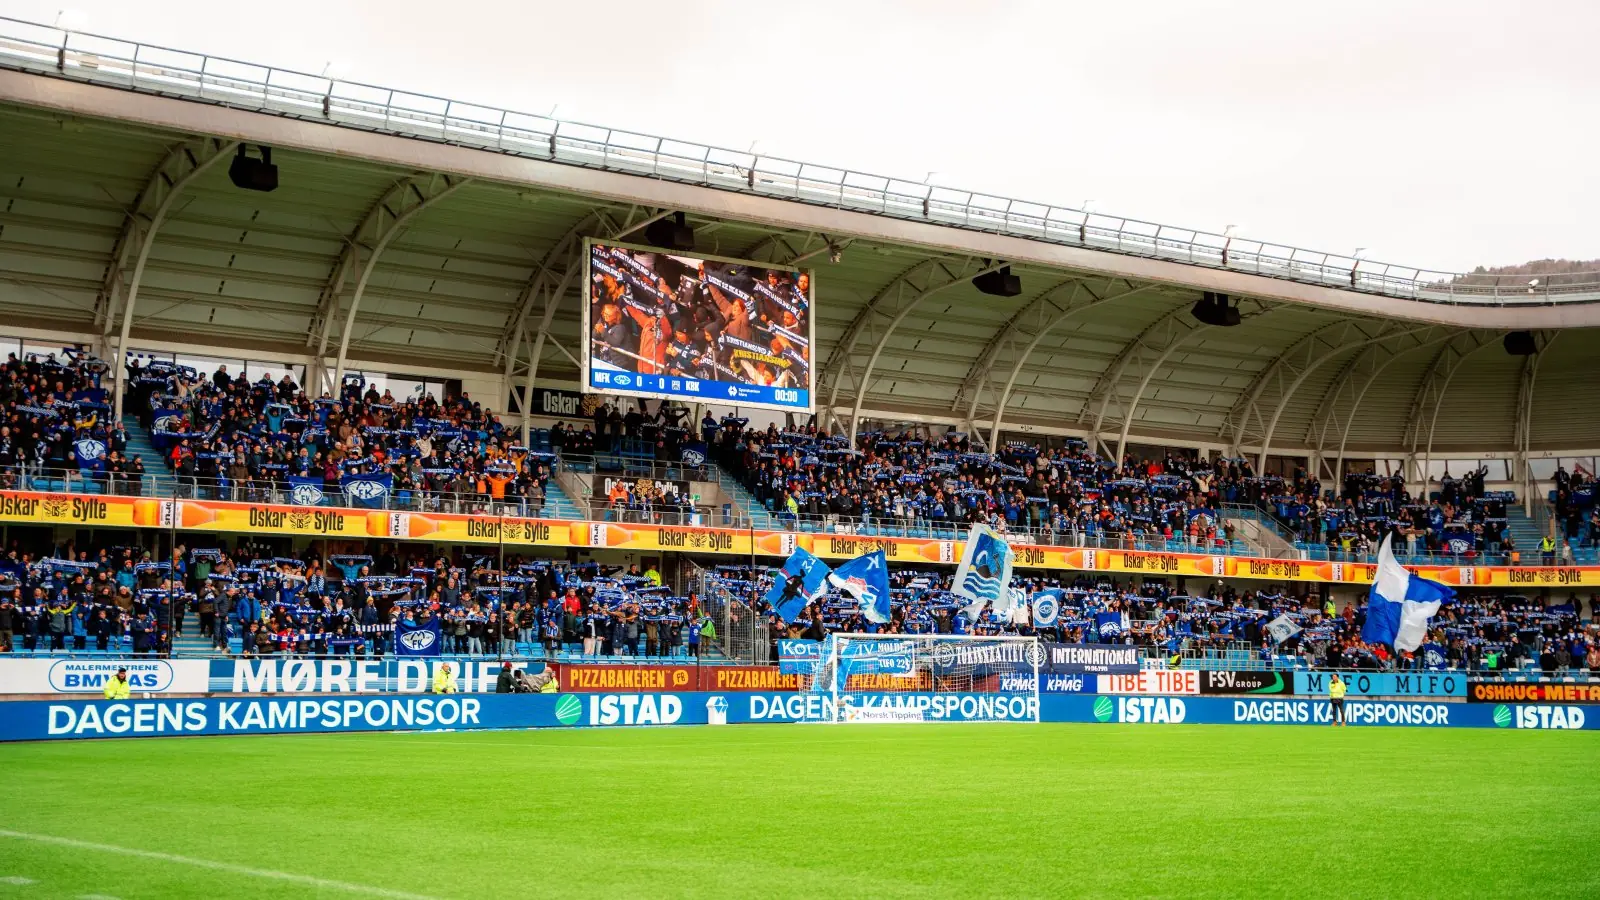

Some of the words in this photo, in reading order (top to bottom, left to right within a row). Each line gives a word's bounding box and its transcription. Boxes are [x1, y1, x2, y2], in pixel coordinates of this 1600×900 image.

[594, 372, 610, 383] MFK
[636, 376, 642, 387] 0
[659, 378, 664, 389] 0
[686, 381, 700, 392] KBK
[543, 392, 579, 414] Oskar
[775, 389, 798, 402] 00:00
[72, 498, 107, 522] Sylte
[250, 507, 286, 528] Oskar
[314, 511, 344, 533] Sylte
[468, 519, 500, 538] Oskar
[524, 521, 549, 542] Sylte
[658, 528, 687, 546] Oskar
[709, 531, 732, 551] Sylte
[831, 538, 857, 554] Oskar
[1025, 548, 1044, 565] Sylte
[1124, 553, 1145, 568] Oskar
[1161, 555, 1178, 572] Sylte
[1250, 560, 1270, 575] Oskar
[1284, 562, 1300, 578] Sylte
[1509, 569, 1537, 583] Oskar
[1559, 569, 1581, 584] Sylte
[1052, 648, 1138, 665] INTERNATIONAL
[129, 674, 158, 687] AS
[232, 659, 380, 692] MØRE
[570, 669, 665, 688] PIZZABAKEREN
[1002, 679, 1036, 690] KPMG
[1046, 678, 1082, 692] KPMG
[1156, 672, 1194, 692] TIBE
[1209, 672, 1236, 688] FSV
[1396, 676, 1455, 694] MIFO
[1475, 685, 1538, 700] OSHAUG
[48, 702, 207, 735] DAGENS
[218, 698, 480, 730] KAMPSPONSOR
[590, 694, 682, 725] ISTAD
[863, 711, 888, 719] Norsk
[891, 712, 922, 721] Tipping
[1118, 698, 1186, 723] ISTAD
[1234, 701, 1308, 722] DAGENS
[1516, 706, 1585, 729] ISTAD
